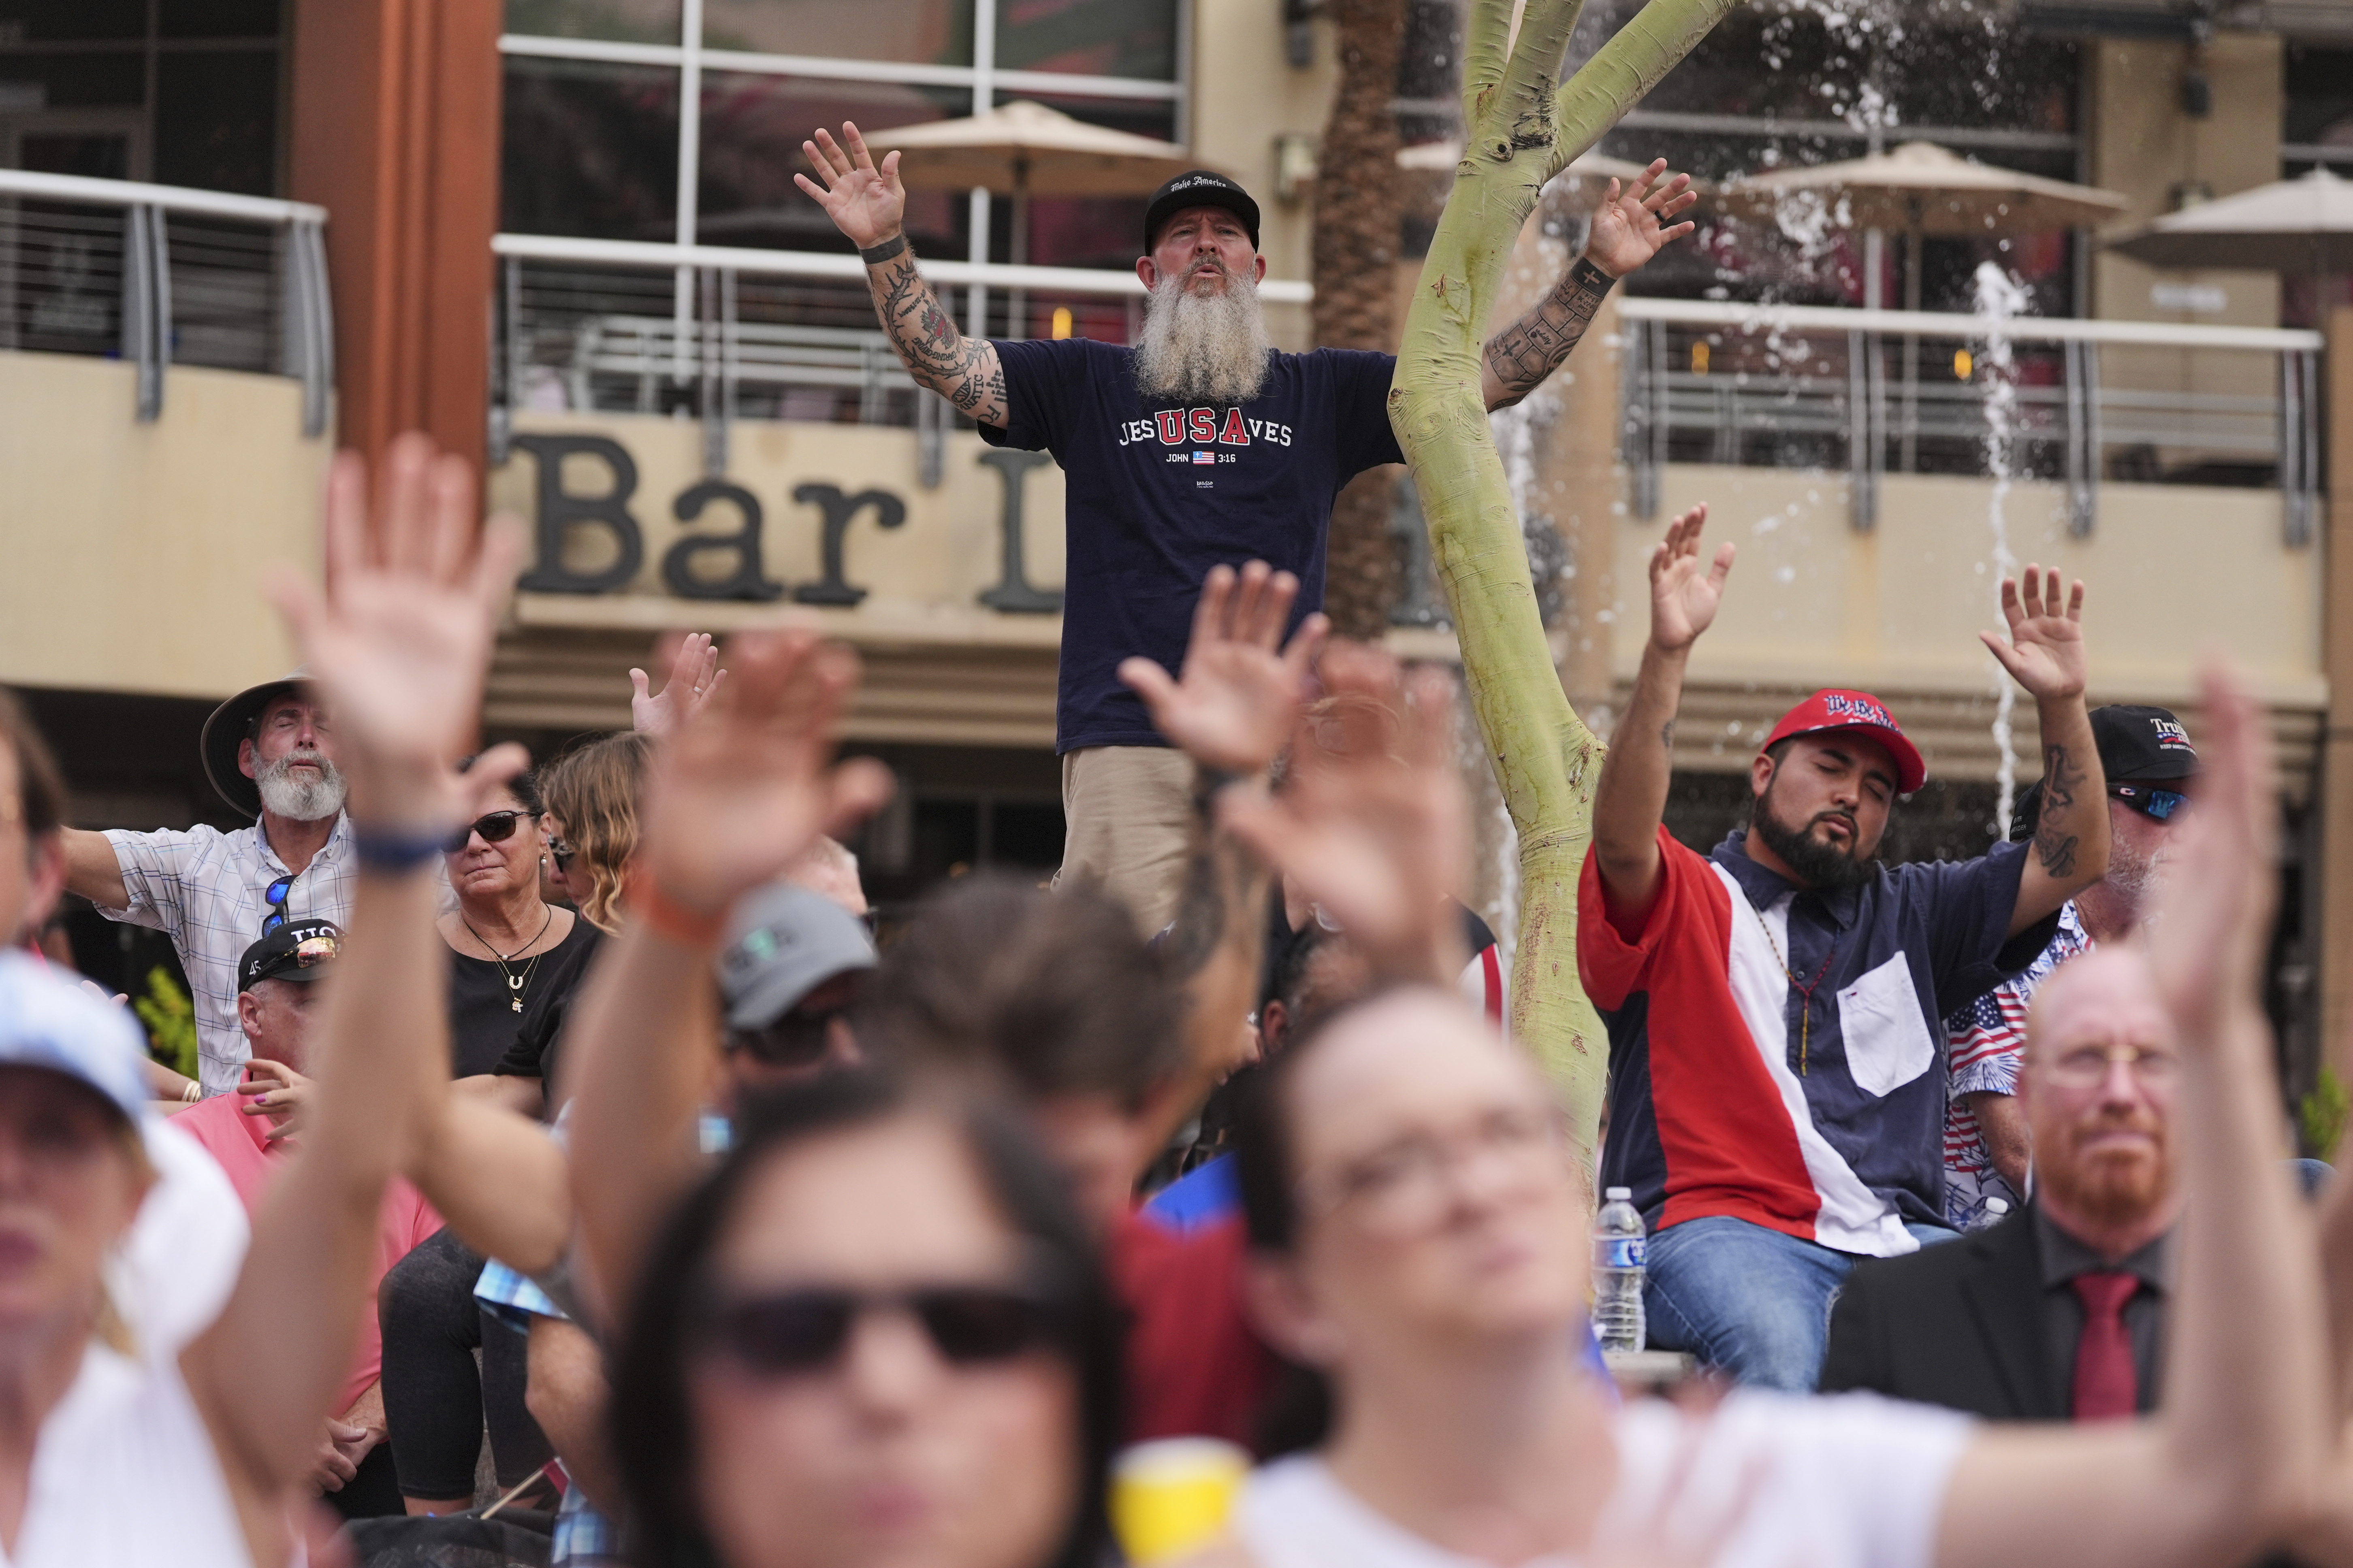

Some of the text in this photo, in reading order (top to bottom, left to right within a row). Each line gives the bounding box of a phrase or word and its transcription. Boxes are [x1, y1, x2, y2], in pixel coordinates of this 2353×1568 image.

[1171, 179, 1191, 192] Make
[1166, 454, 1236, 462] JOHN 3:16
[512, 433, 907, 604] Bar
[1824, 695, 1853, 716] We
[249, 960, 261, 975] 45
